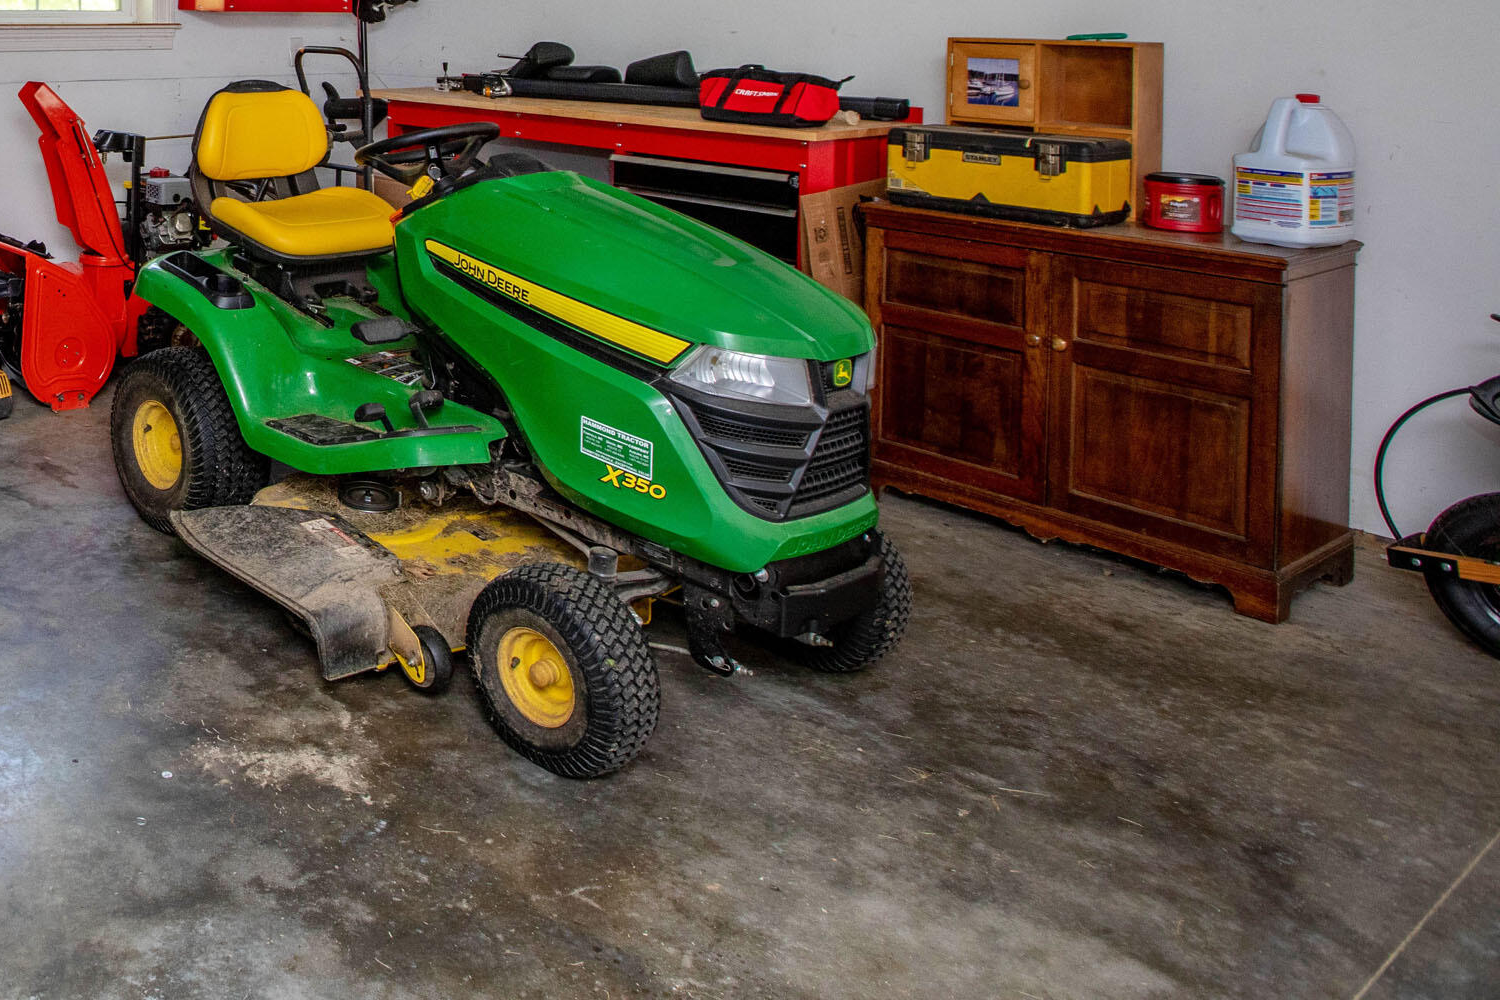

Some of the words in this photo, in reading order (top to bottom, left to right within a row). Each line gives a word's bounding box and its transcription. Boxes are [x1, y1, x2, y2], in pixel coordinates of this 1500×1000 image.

[735, 88, 780, 97] CRAFTSMAN
[965, 154, 998, 163] STANLEY
[453, 254, 485, 280] JOHN
[487, 270, 530, 303] DEERE
[583, 418, 616, 436] HAMMOND
[617, 432, 649, 449] TRACTOR
[599, 464, 667, 499] X350
